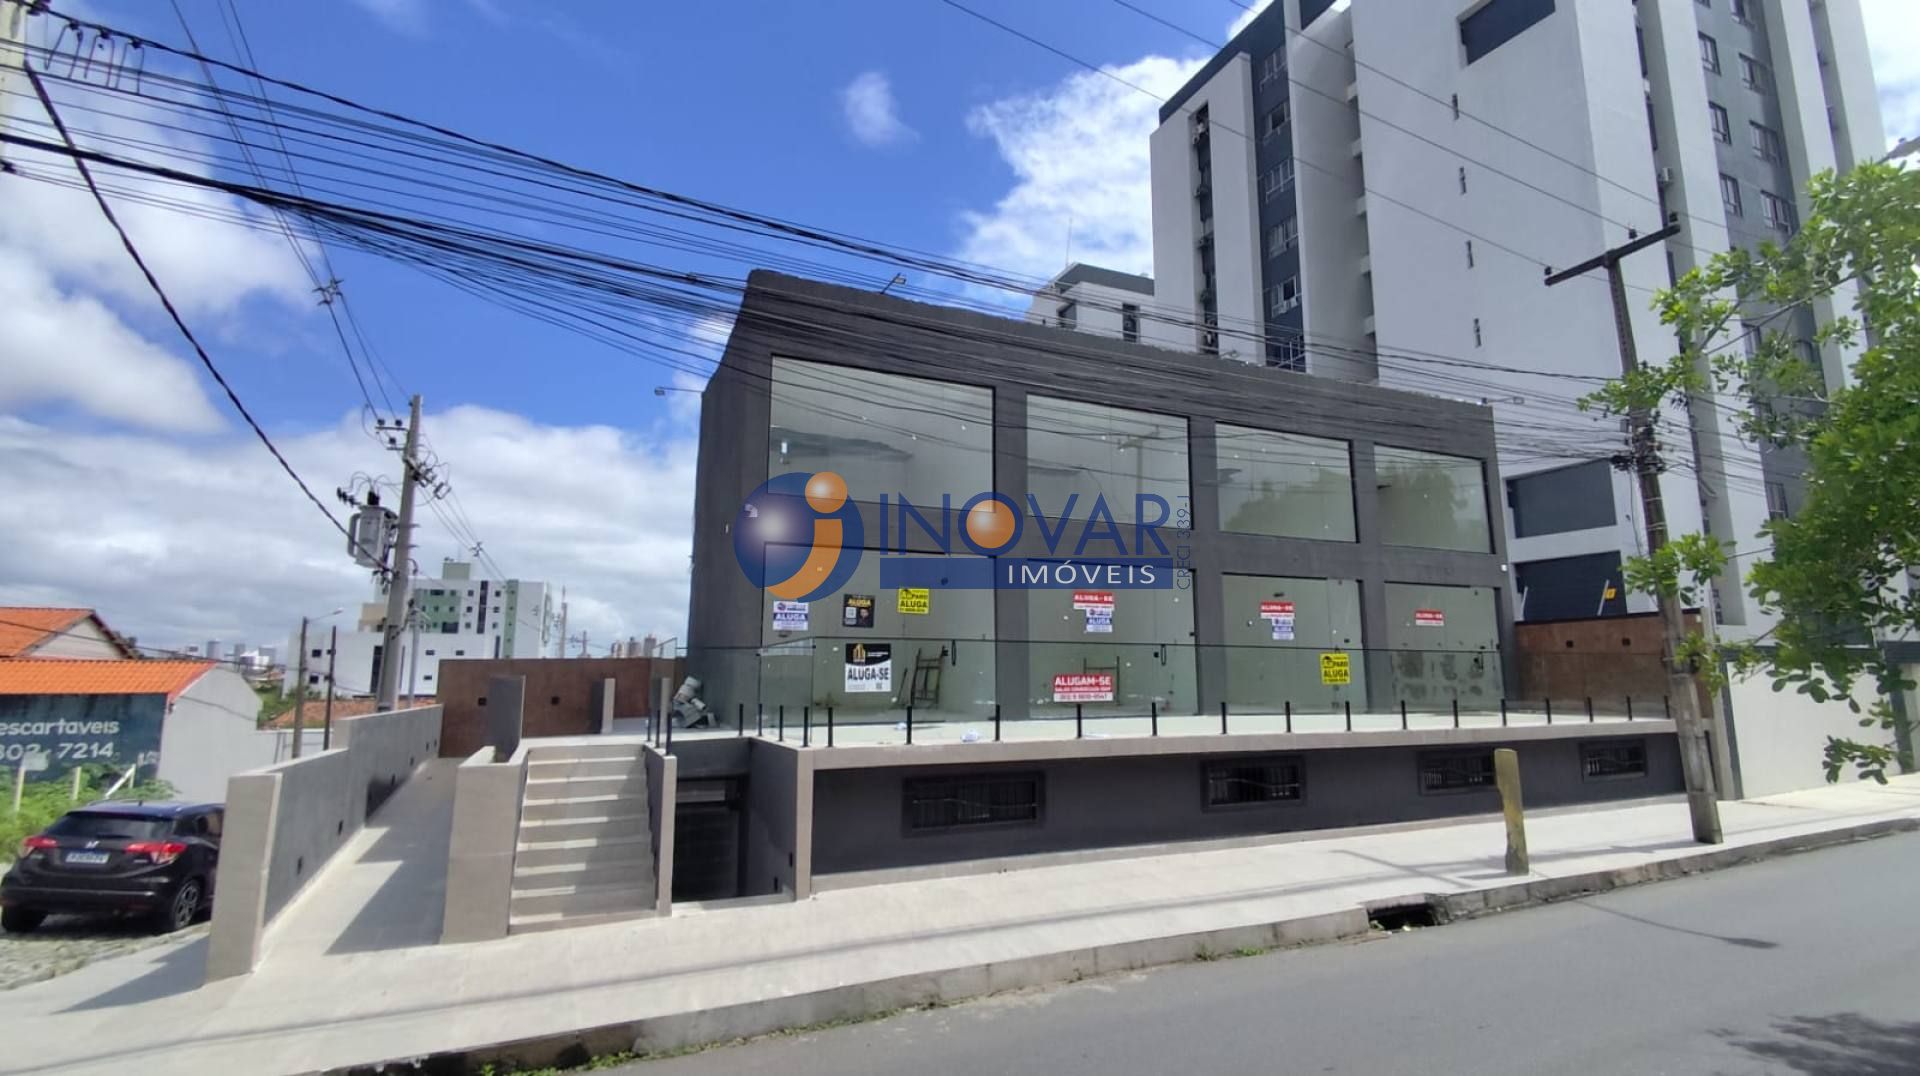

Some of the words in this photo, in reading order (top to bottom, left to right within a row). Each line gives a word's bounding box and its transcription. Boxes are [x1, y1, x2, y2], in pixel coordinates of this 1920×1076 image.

[900, 600, 928, 608] ALUGA
[847, 667, 889, 680] ALUGA-SE
[1324, 669, 1349, 678] ALUGA
[1055, 675, 1111, 686] ALUGAM-SE
[58, 741, 114, 759] 7214
